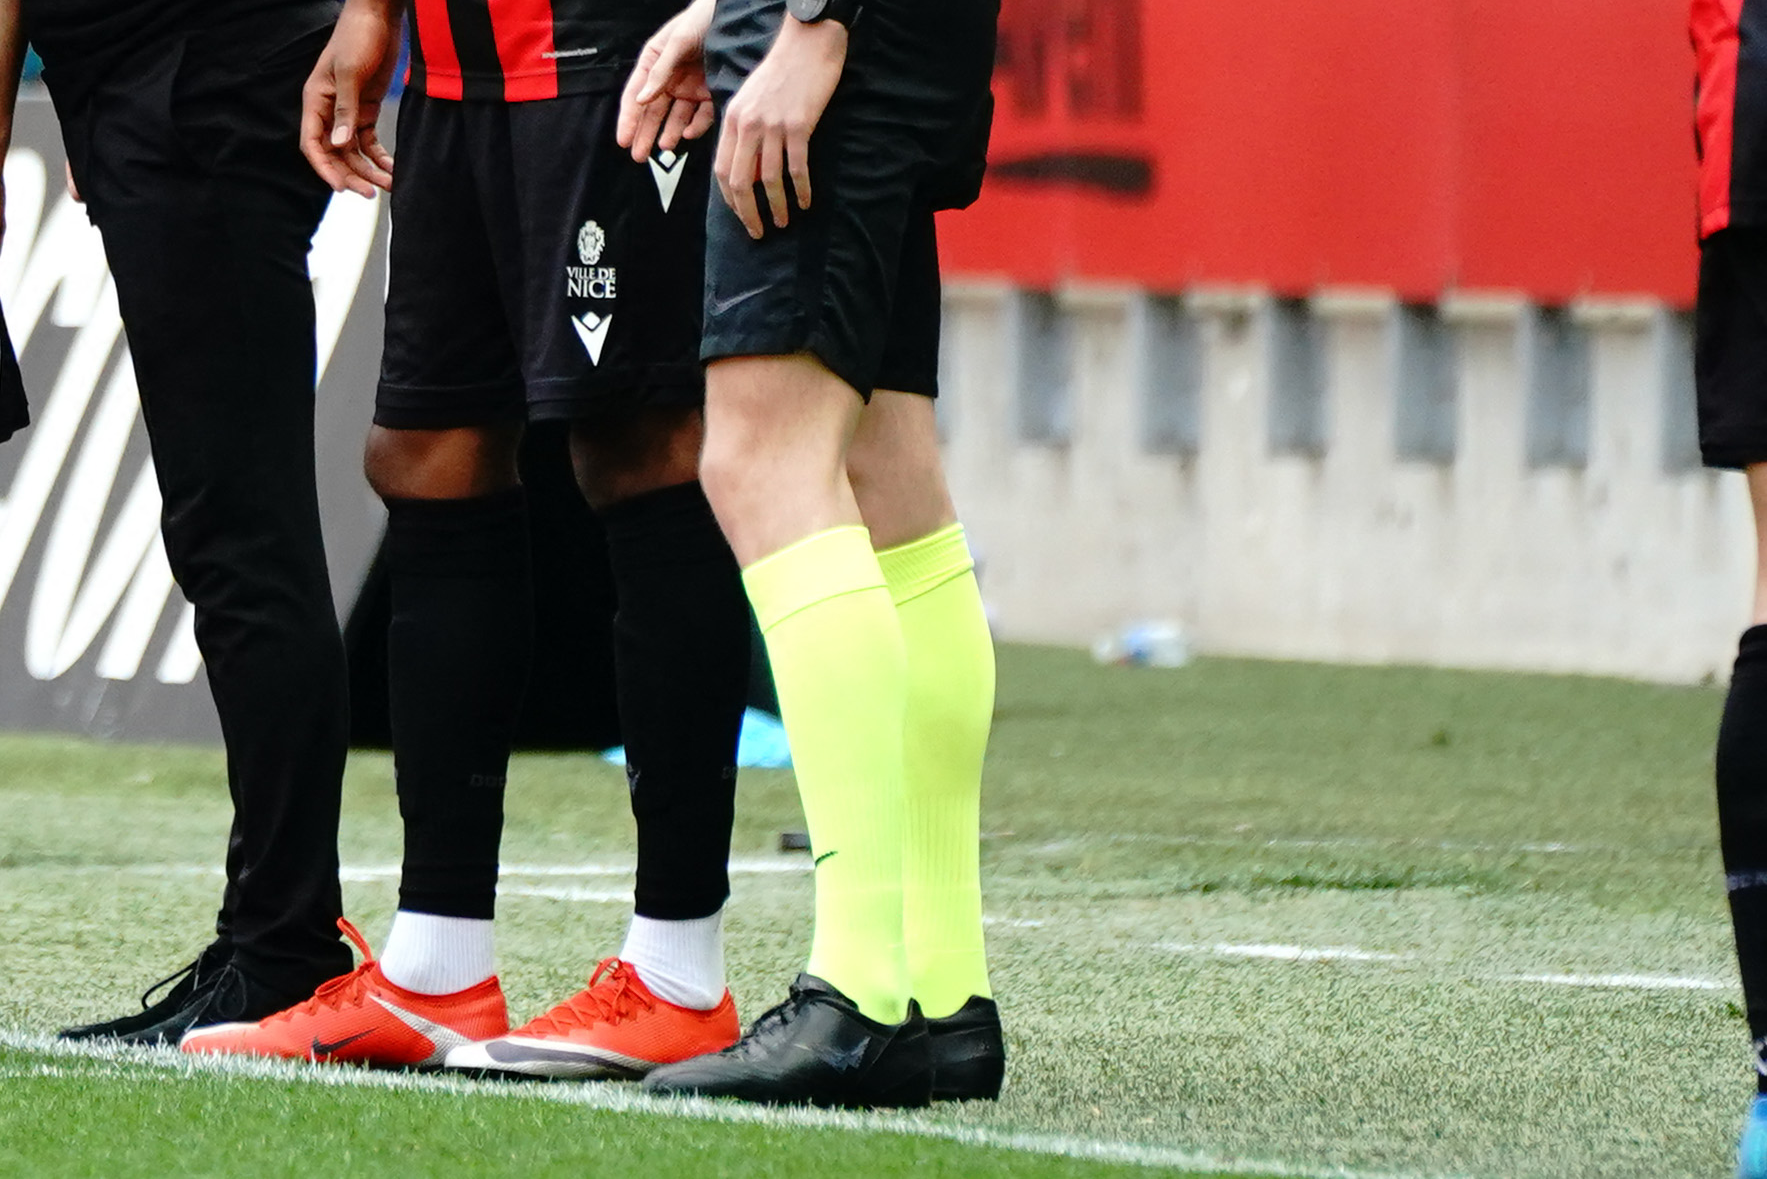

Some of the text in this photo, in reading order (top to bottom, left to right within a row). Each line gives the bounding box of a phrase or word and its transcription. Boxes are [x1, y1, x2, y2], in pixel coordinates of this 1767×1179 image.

[566, 266, 617, 281] VILLE DE
[566, 278, 617, 299] NICE
